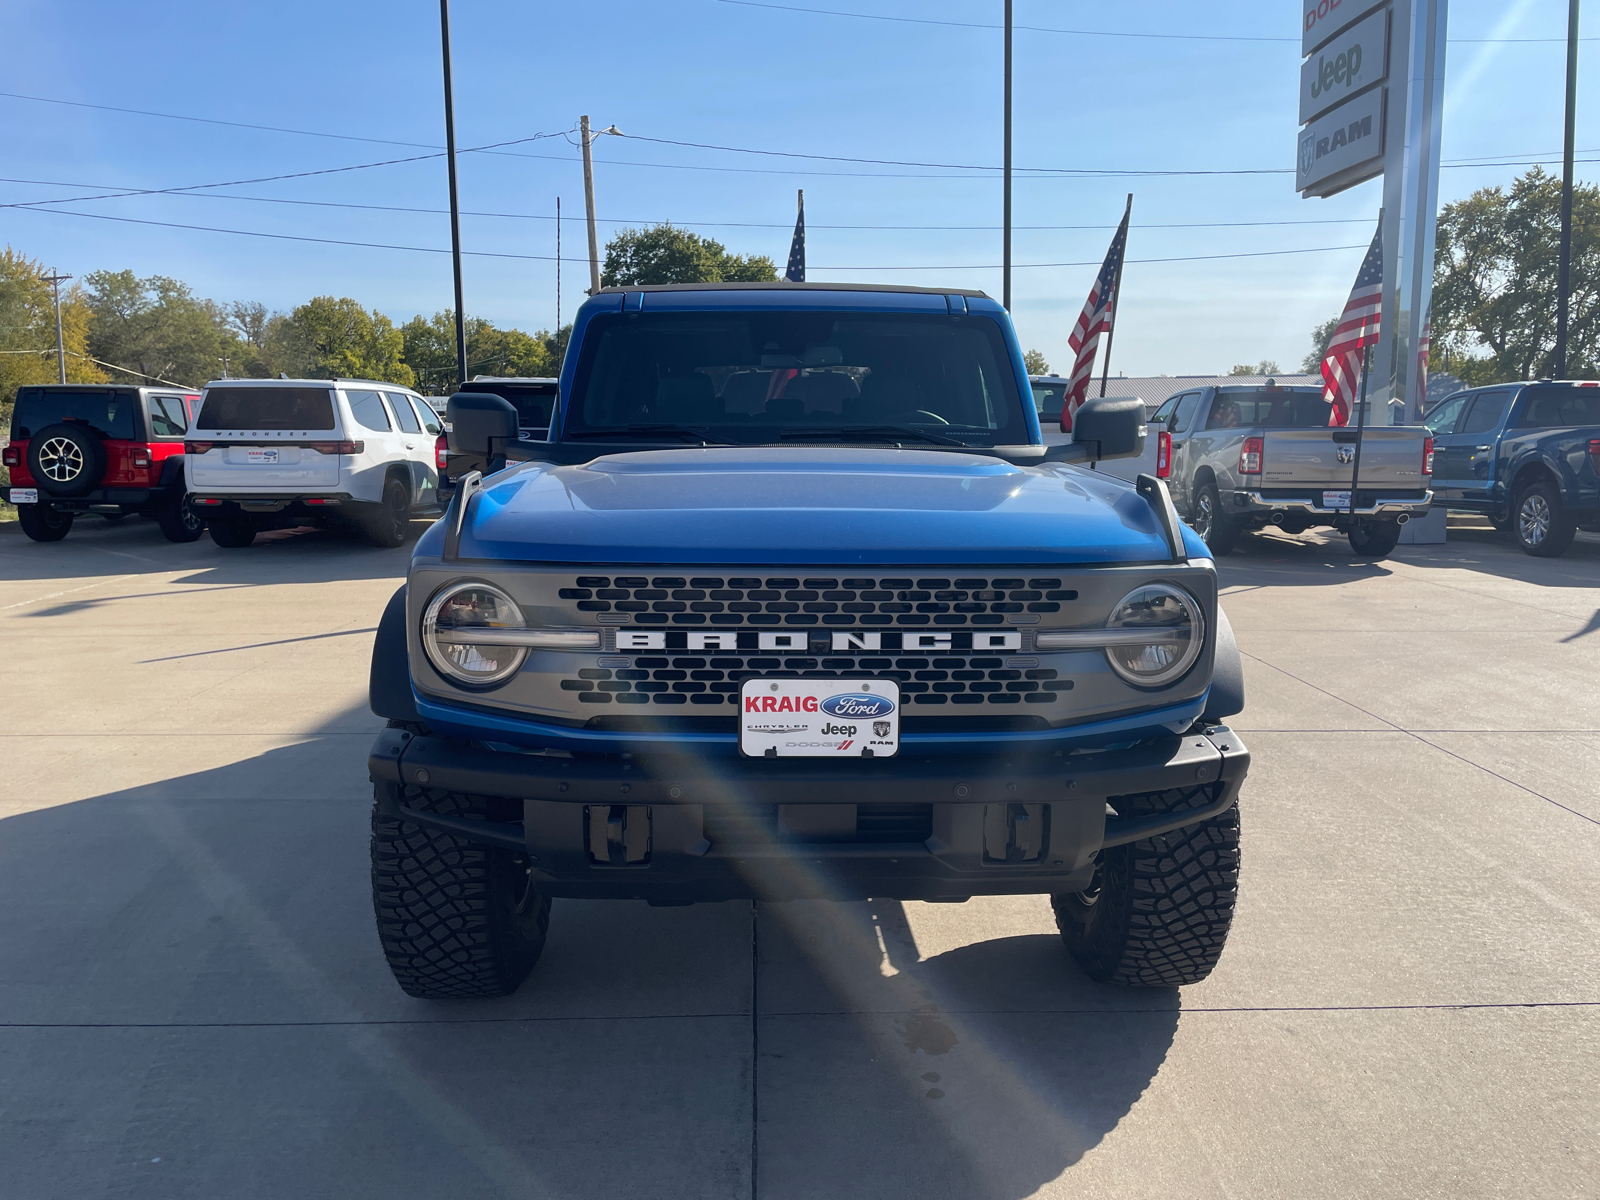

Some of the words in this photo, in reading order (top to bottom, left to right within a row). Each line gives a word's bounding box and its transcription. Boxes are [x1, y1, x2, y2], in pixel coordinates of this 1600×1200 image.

[1311, 43, 1362, 99] Jeep
[1315, 114, 1372, 160] RAM
[615, 630, 1022, 650] BRONCO
[745, 696, 818, 713] KRAIG
[834, 696, 879, 715] Ford
[821, 722, 857, 737] Jeep
